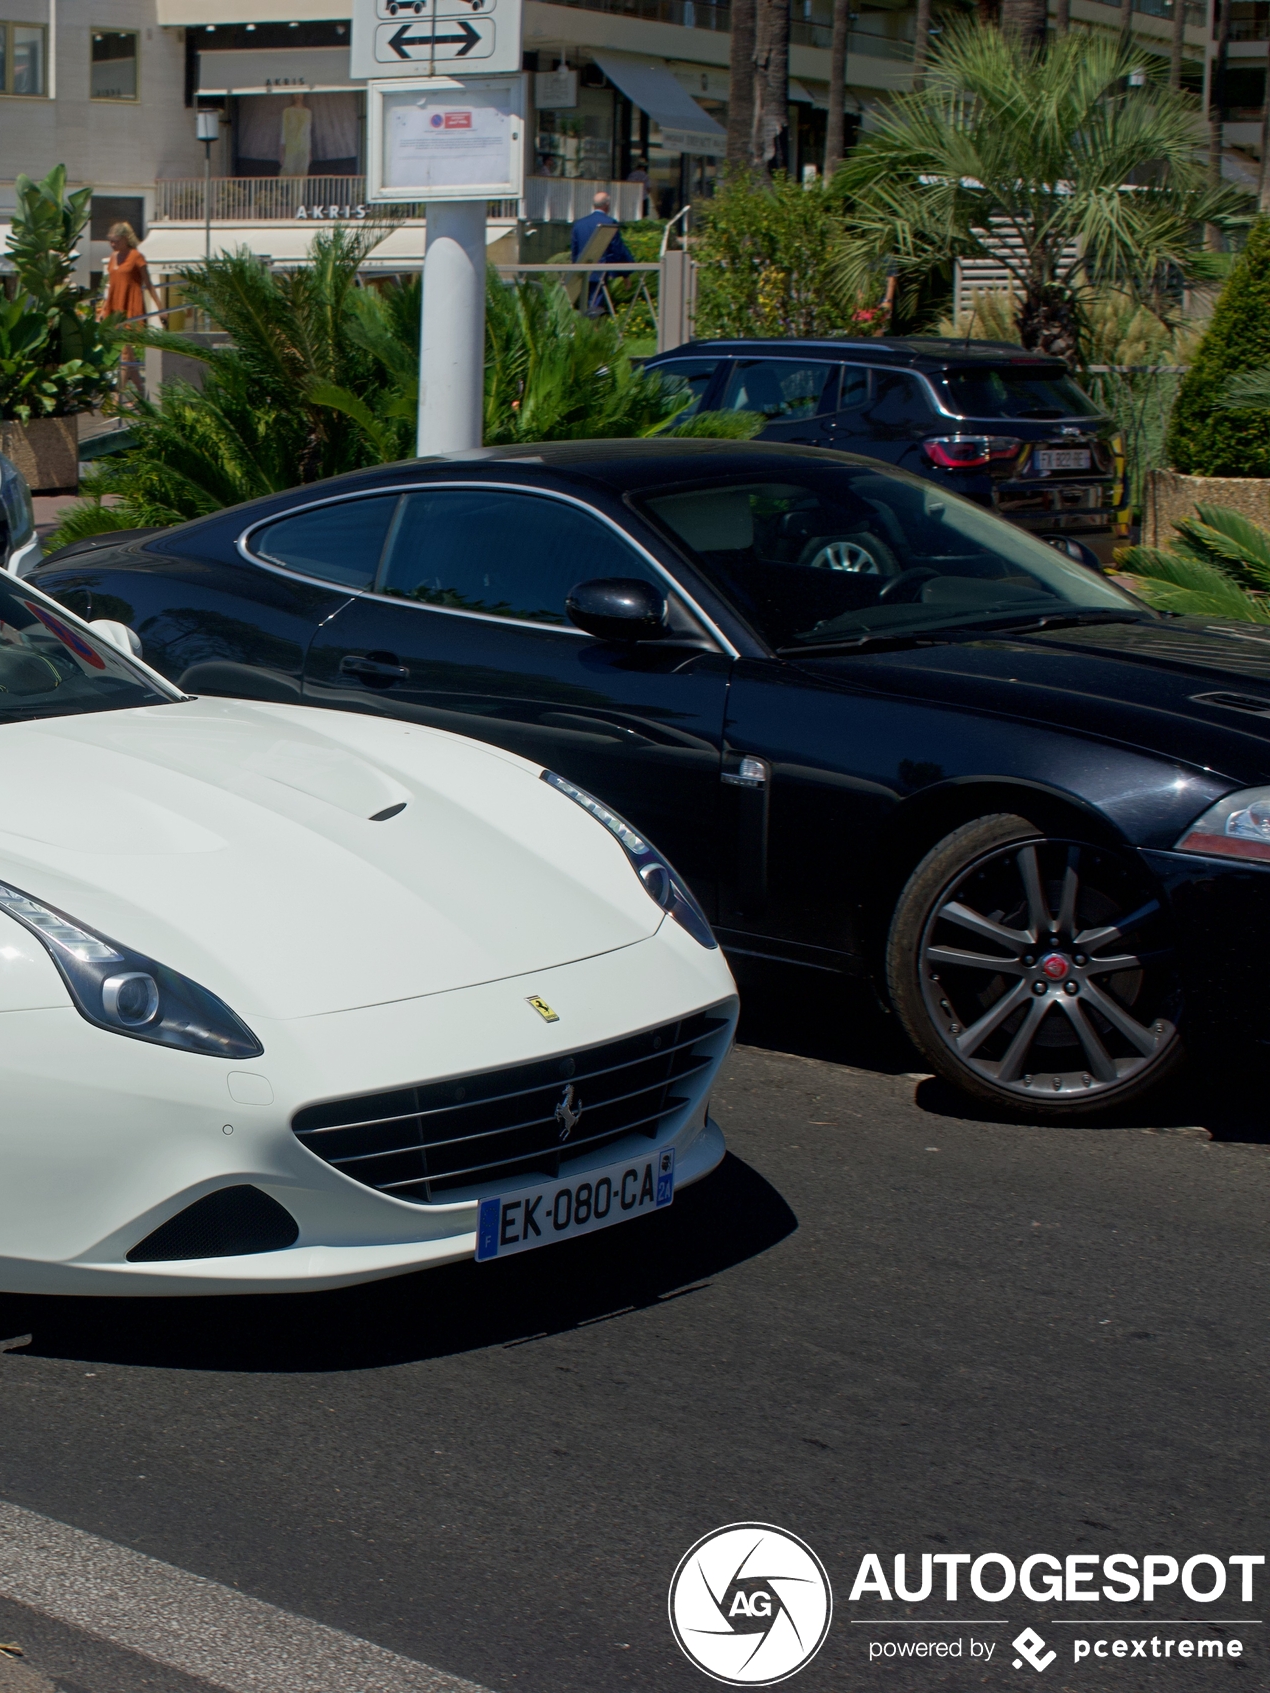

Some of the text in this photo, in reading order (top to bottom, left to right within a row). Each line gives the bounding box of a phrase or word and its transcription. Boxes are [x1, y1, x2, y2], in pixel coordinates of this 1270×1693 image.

[296, 204, 366, 219] AKRIS
[658, 1181, 671, 1201] 2A
[500, 1163, 655, 1246] EK-080-CA
[484, 1235, 492, 1248] F
